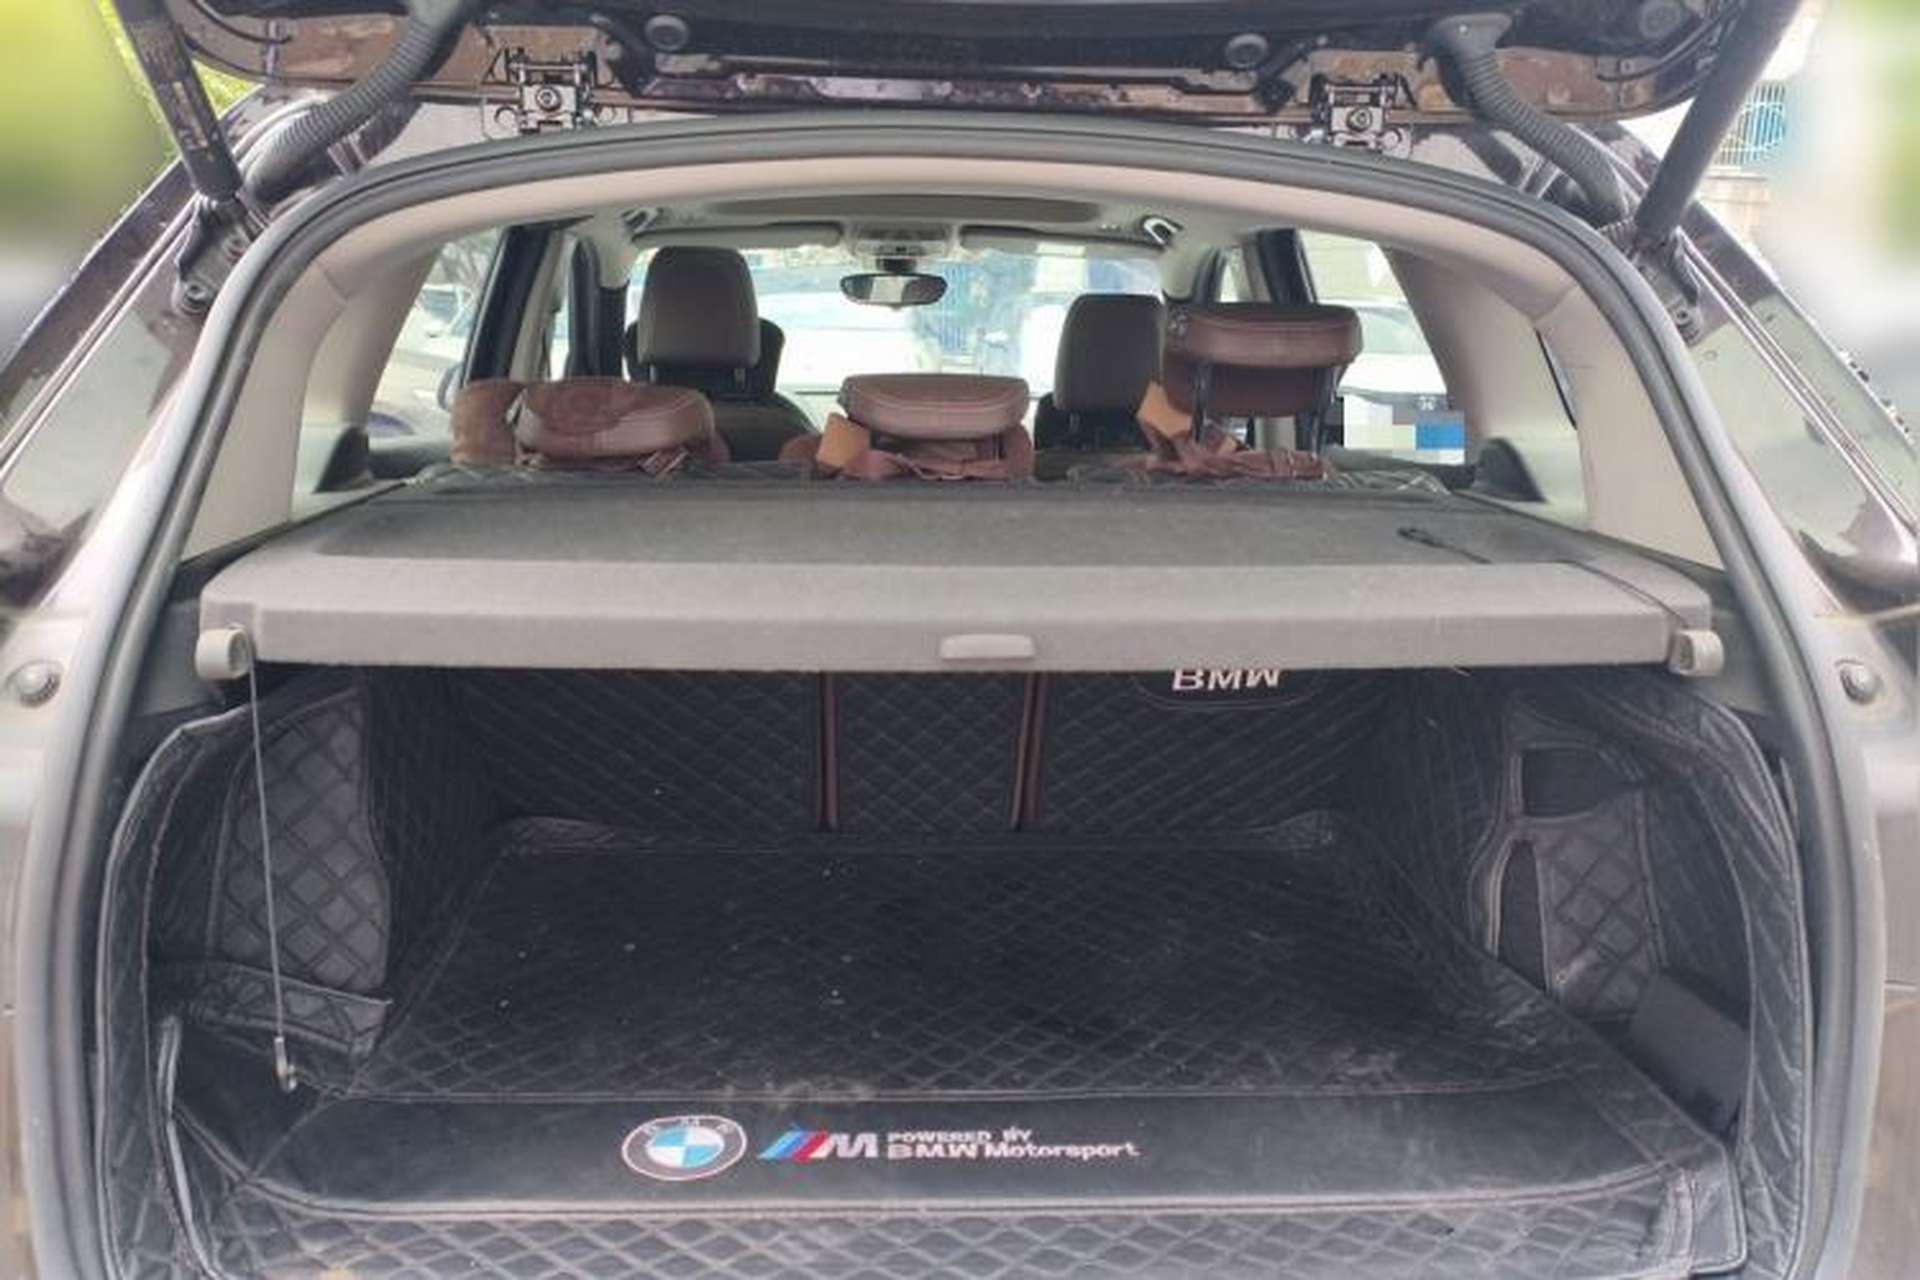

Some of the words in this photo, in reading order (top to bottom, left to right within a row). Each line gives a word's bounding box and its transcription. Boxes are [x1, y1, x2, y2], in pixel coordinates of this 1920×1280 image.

[1172, 667, 1280, 691] BMW
[887, 1131, 991, 1143] POWERED
[887, 1143, 978, 1160] BMW
[984, 1142, 1140, 1161] Motorsport
